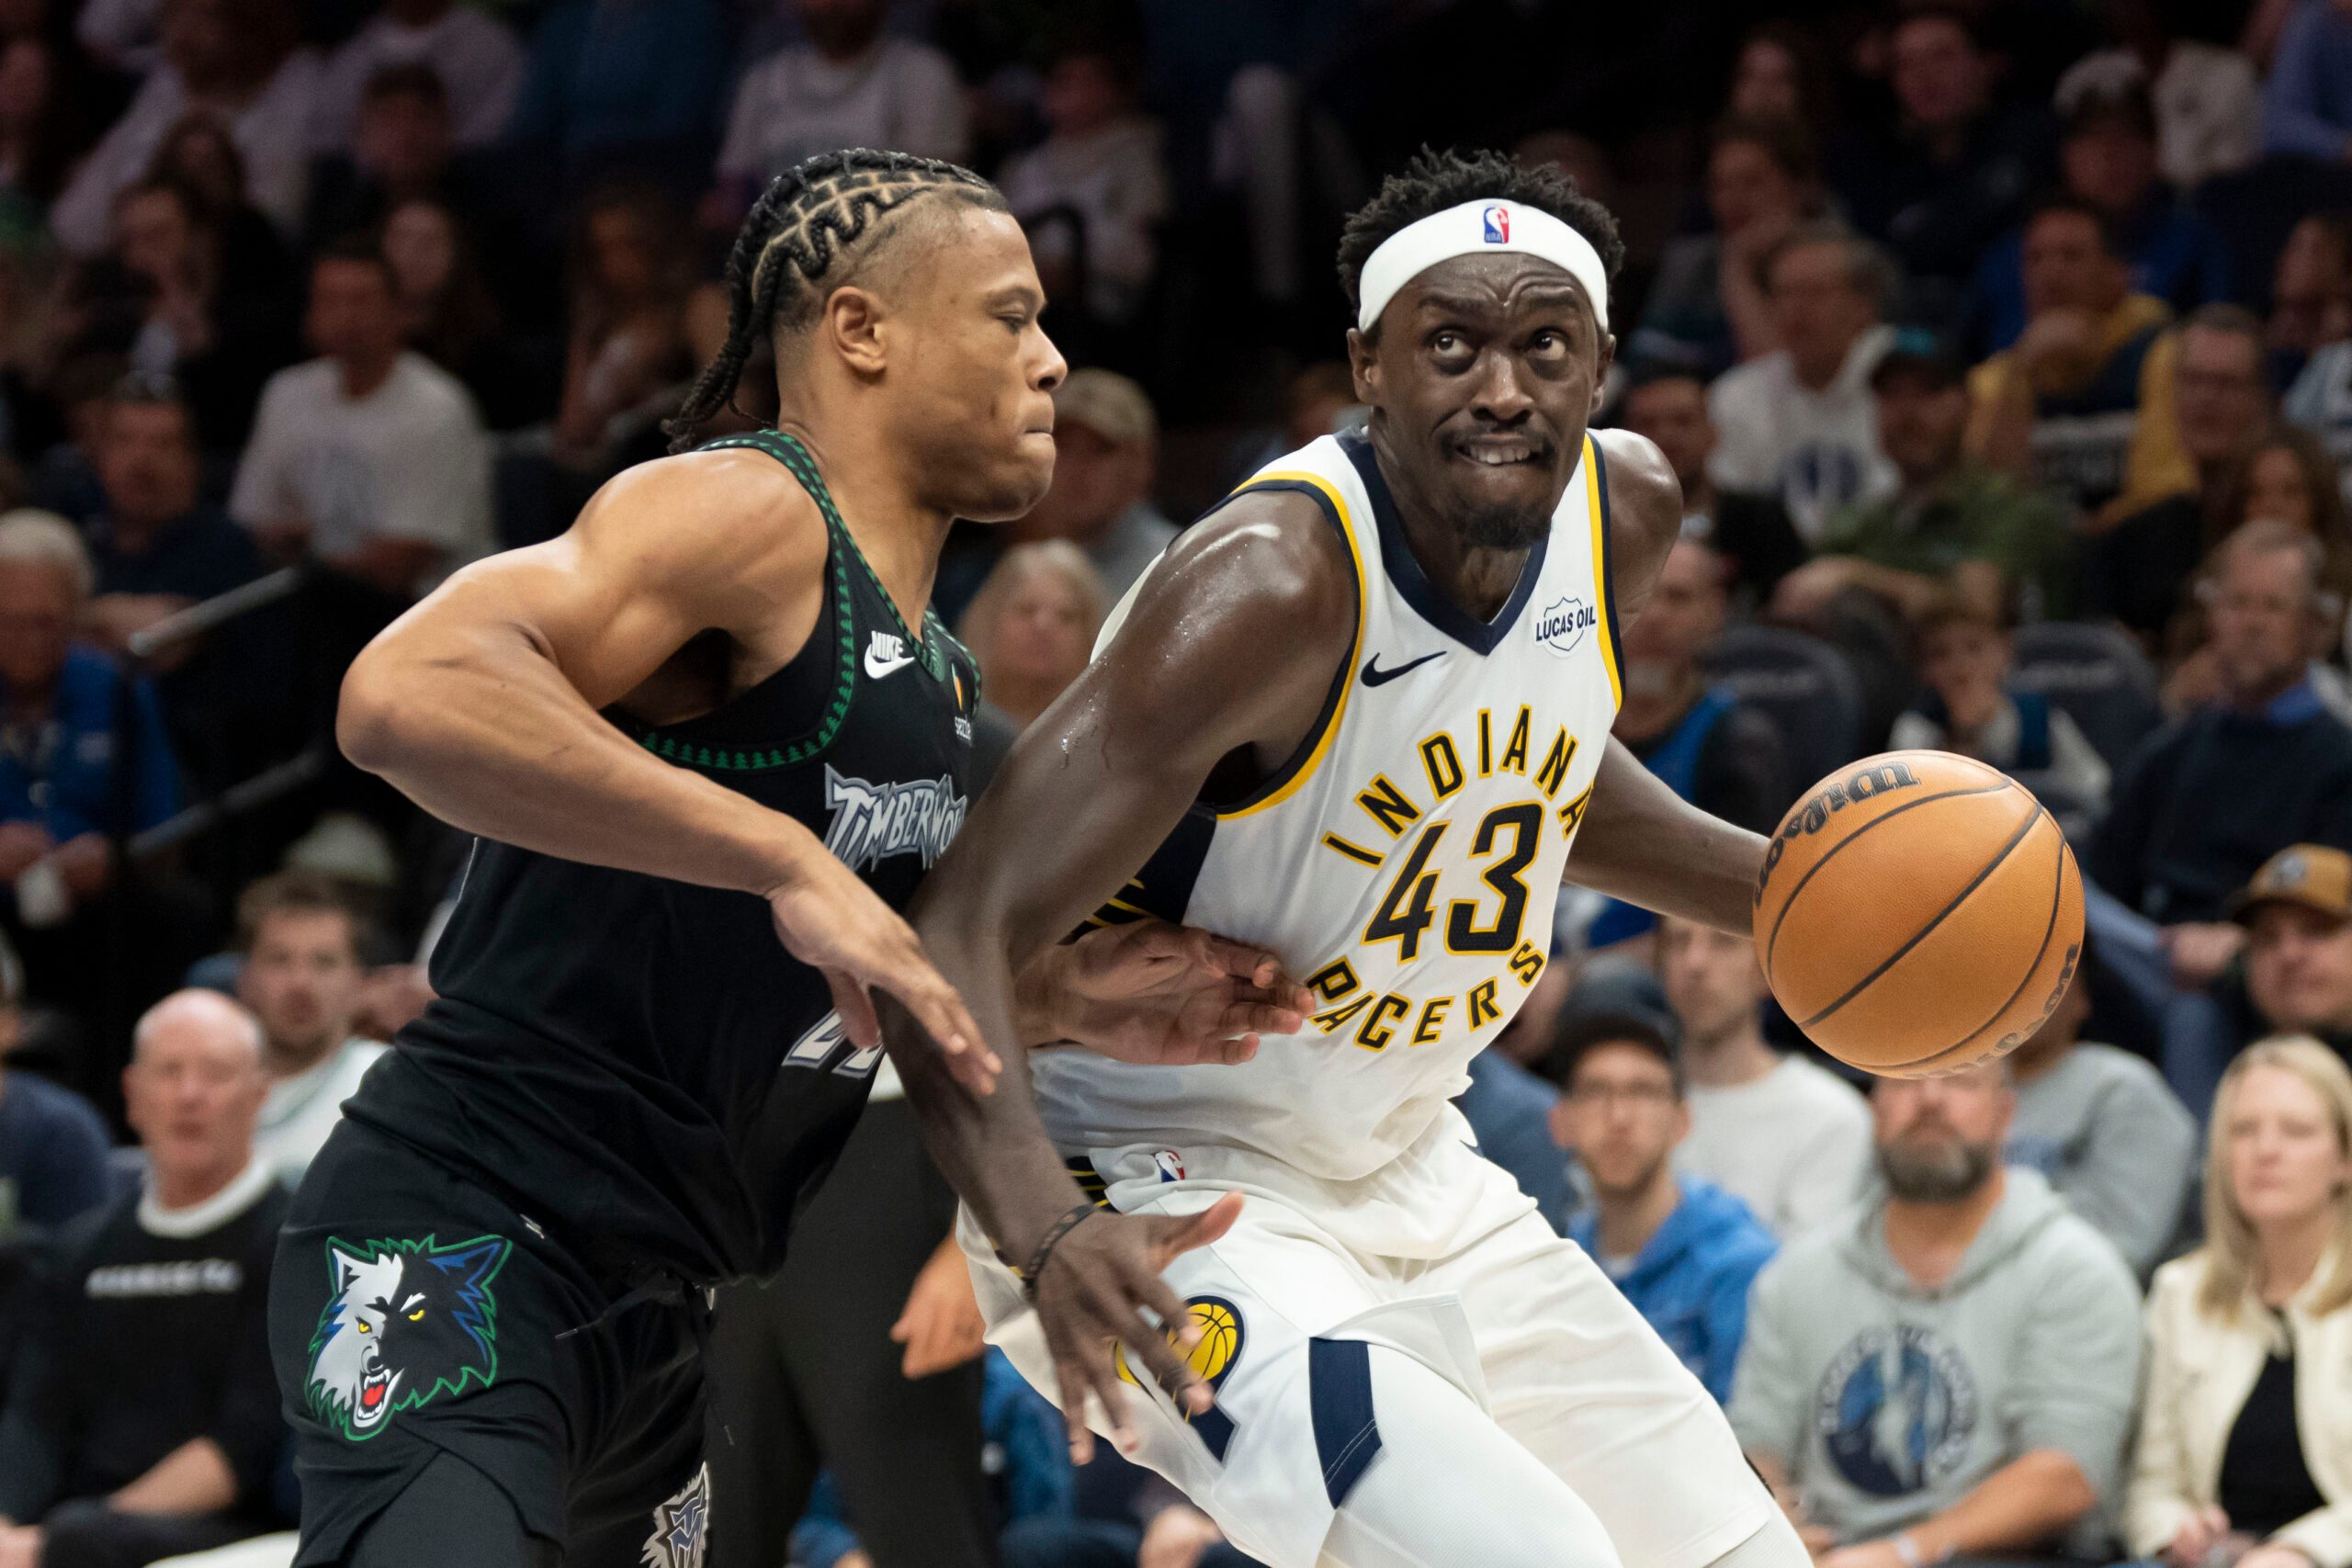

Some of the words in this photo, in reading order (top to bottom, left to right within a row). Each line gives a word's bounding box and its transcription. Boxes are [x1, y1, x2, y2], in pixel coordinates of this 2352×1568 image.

[871, 630, 903, 661] NIKE
[1535, 612, 1574, 642] LUCAS
[1577, 605, 1596, 629] OIL
[1319, 703, 1594, 870] INDIANA
[1360, 798, 1546, 964] 43
[1306, 938, 1548, 1053] PACERS
